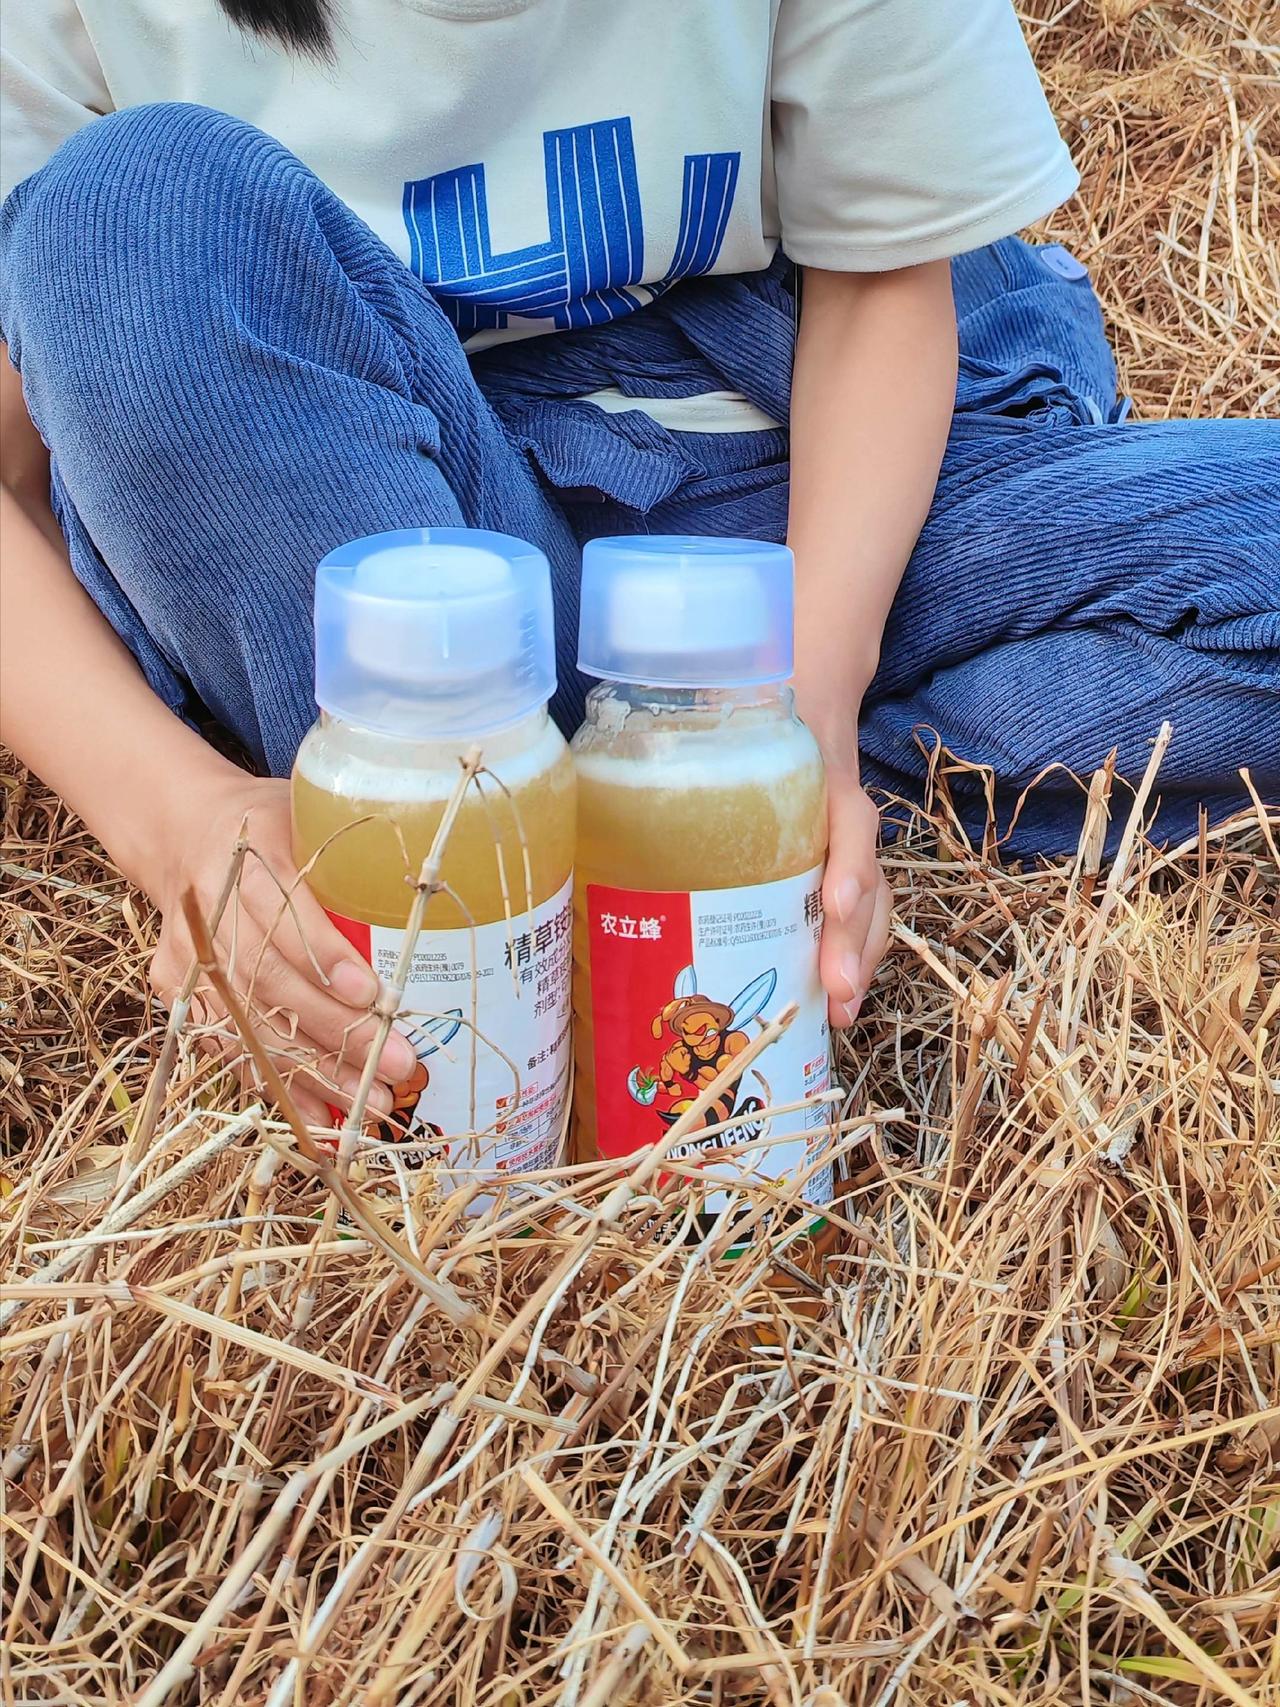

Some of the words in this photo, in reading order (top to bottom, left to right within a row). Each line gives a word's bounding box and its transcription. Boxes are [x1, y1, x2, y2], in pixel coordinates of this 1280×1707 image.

[504, 898, 571, 970] 精草铵
[600, 912, 662, 941] 农立蜂
